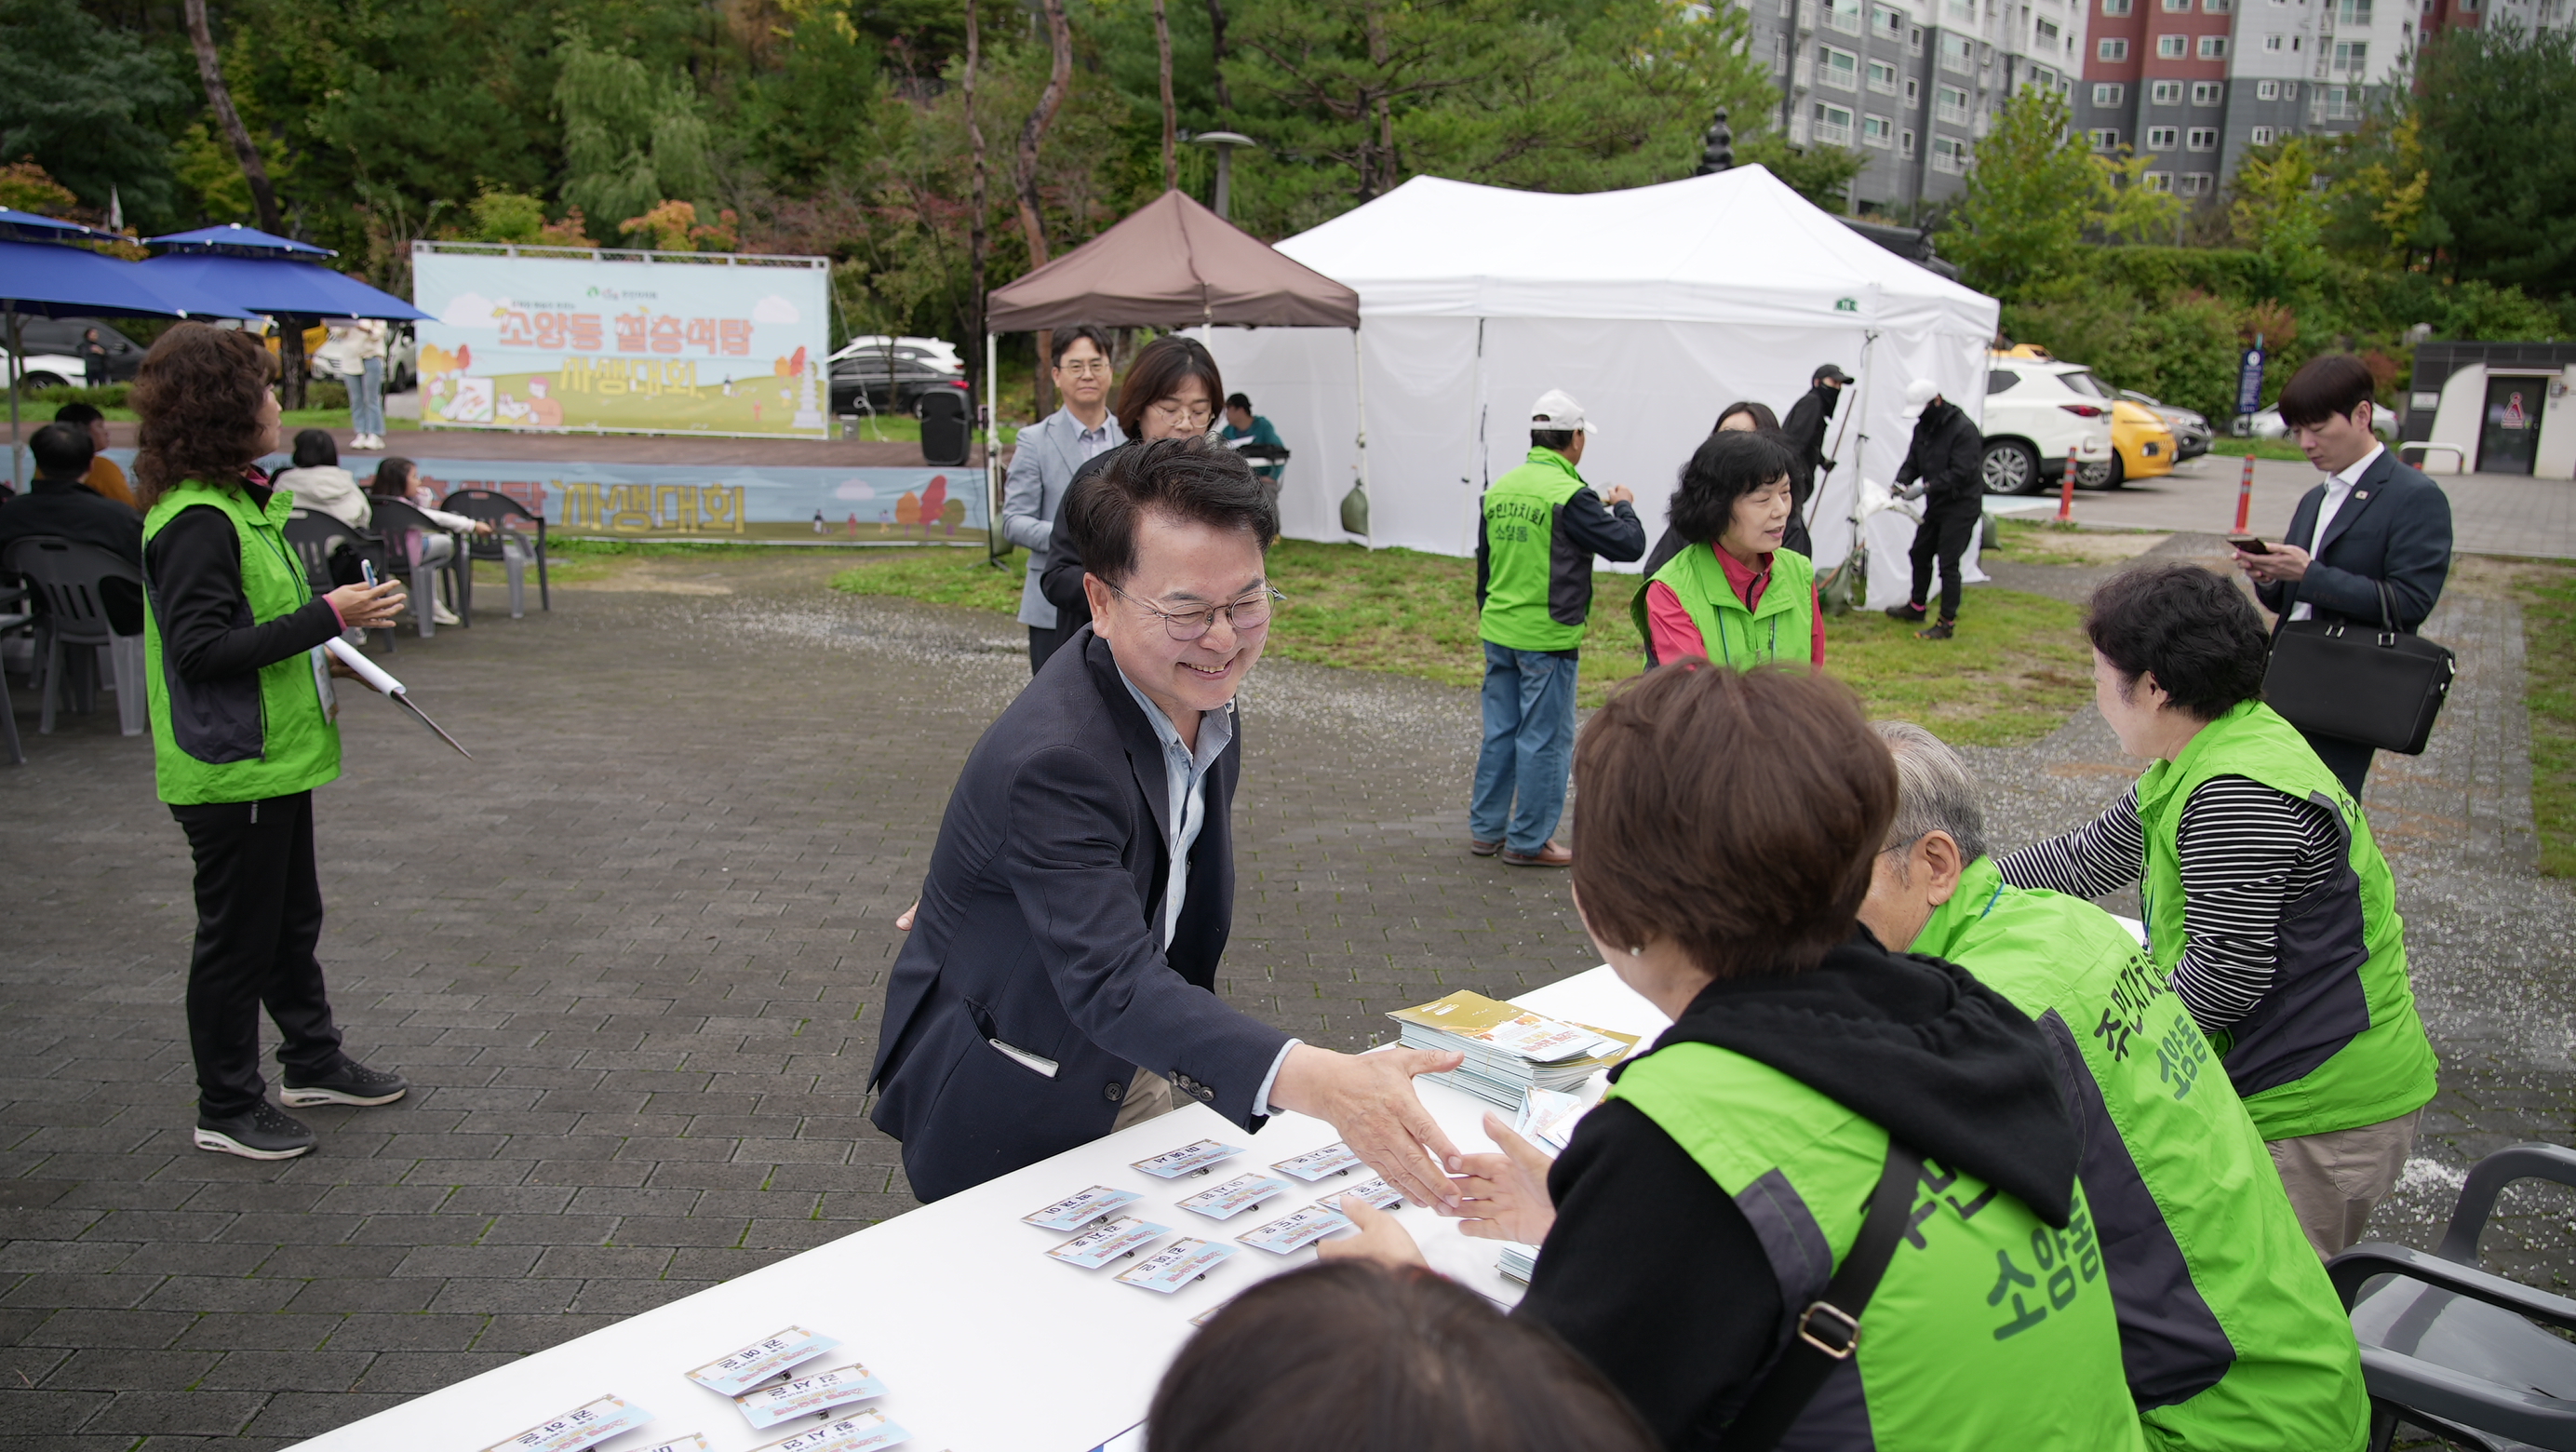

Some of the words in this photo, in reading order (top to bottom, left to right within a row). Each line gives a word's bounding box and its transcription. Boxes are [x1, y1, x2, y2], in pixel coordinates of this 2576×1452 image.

[500, 311, 604, 351] 소양동
[614, 313, 755, 356] 칠층석탑
[559, 356, 700, 398] 사생대회
[560, 480, 744, 534] 사생대회
[2155, 1014, 2208, 1102] 소양동
[1986, 1194, 2100, 1342] 소양동
